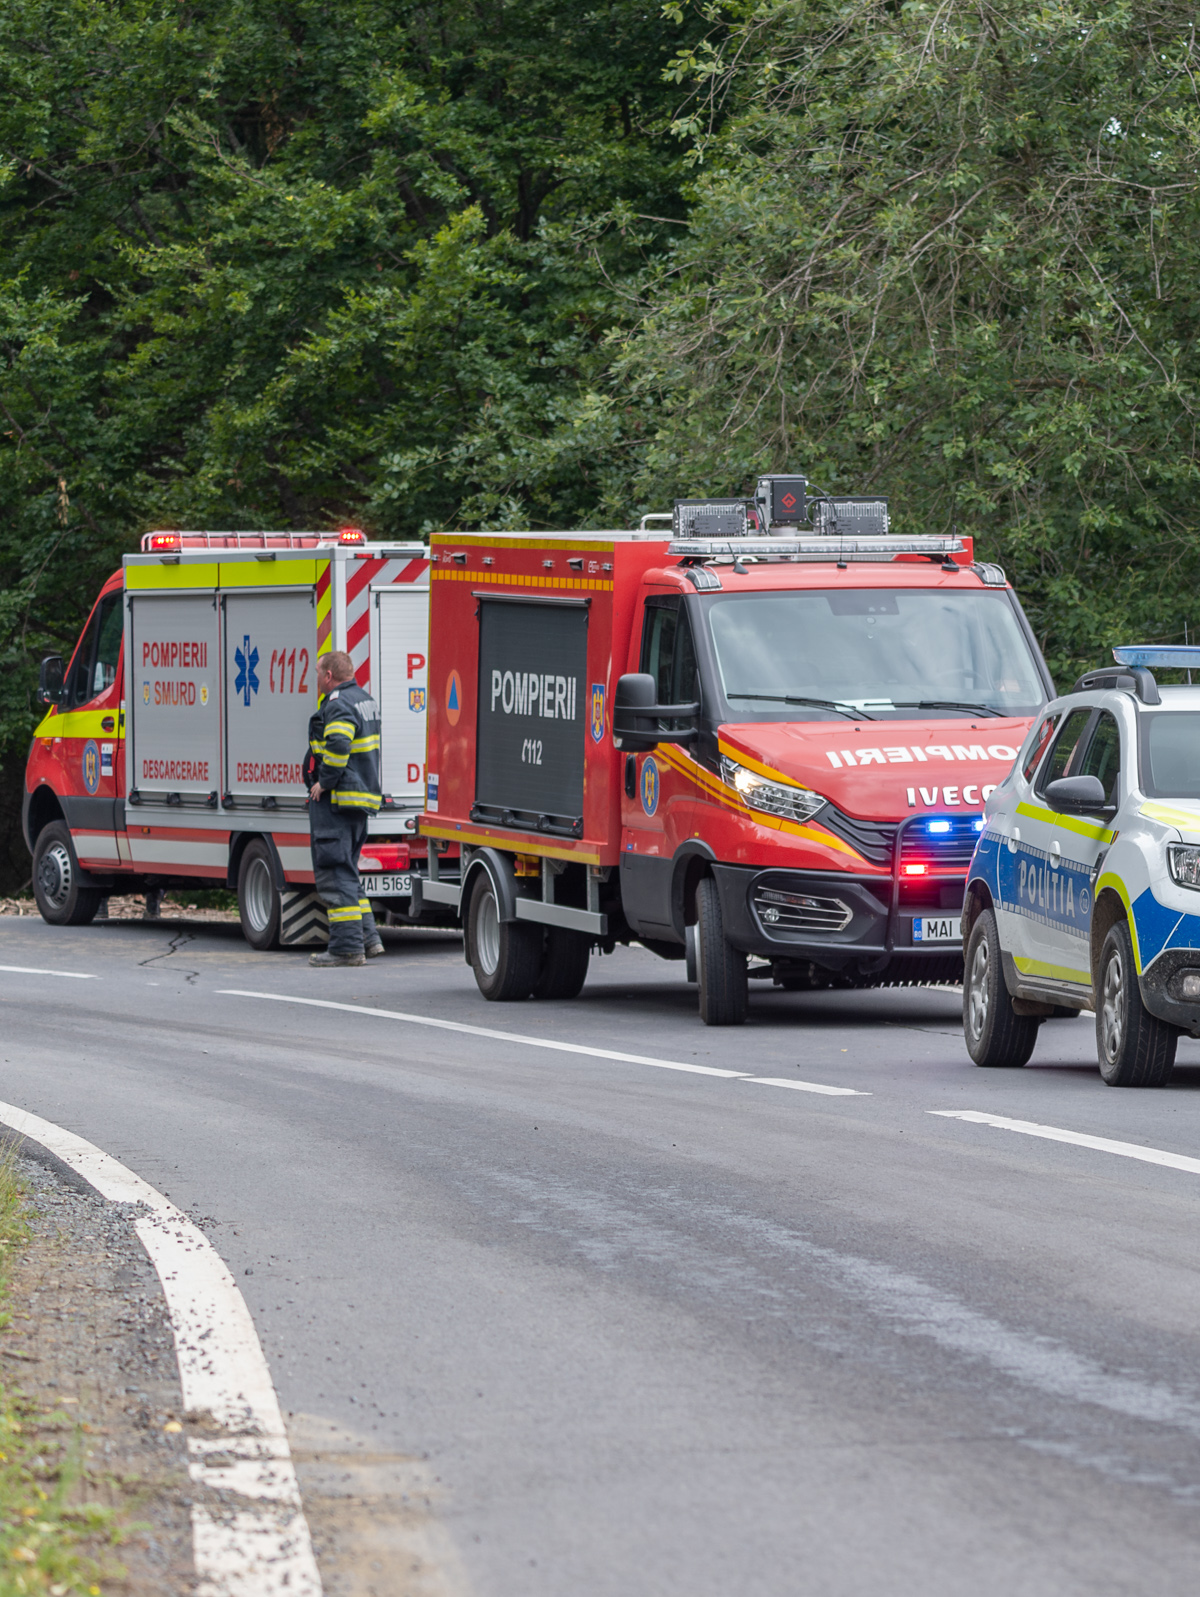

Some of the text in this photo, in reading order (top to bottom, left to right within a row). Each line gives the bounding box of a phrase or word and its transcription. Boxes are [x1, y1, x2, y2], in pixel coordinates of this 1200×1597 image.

[143, 642, 207, 668] POMPIERII
[278, 648, 309, 694] 112
[154, 681, 196, 706] SMURD
[491, 669, 577, 720] POMPIERII
[526, 739, 543, 765] 112
[143, 760, 209, 781] DESCARCERARE
[382, 877, 412, 891] 5169
[1018, 859, 1076, 918] POLITIA
[927, 920, 952, 938] MAI
